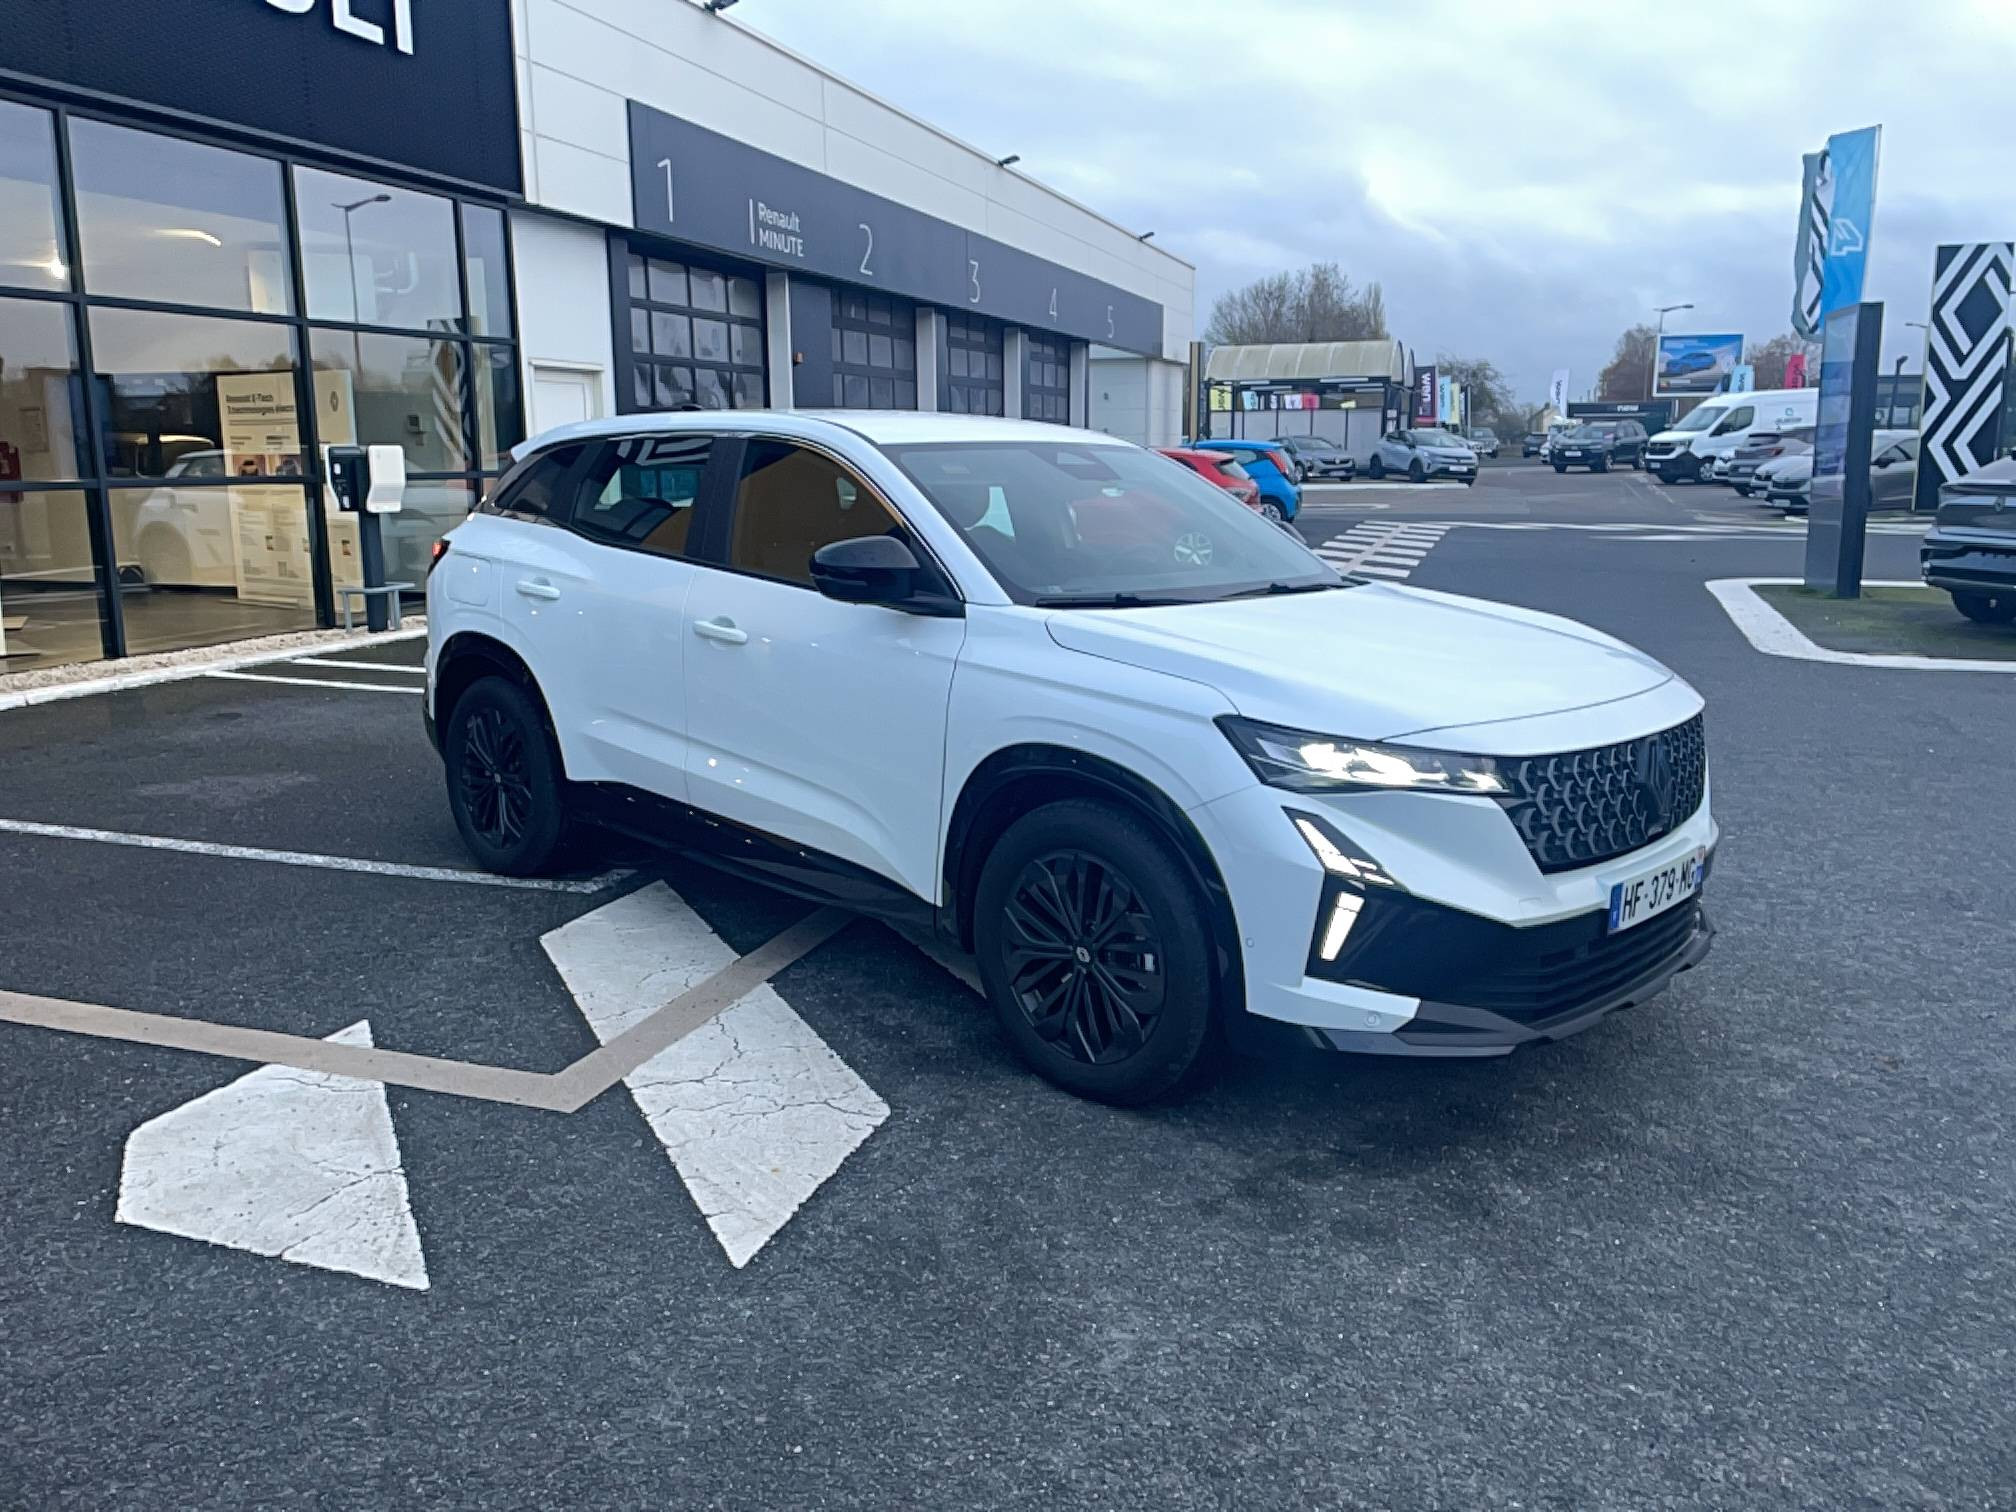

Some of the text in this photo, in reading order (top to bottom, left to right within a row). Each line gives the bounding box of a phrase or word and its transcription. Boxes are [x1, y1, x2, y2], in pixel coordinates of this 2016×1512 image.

[657, 158, 674, 223] 1
[758, 200, 800, 233] Renault
[759, 227, 804, 257] MINUTE
[858, 223, 873, 276] 2
[968, 258, 981, 303] 3
[1049, 287, 1058, 323] 4
[1107, 305, 1115, 339] 5
